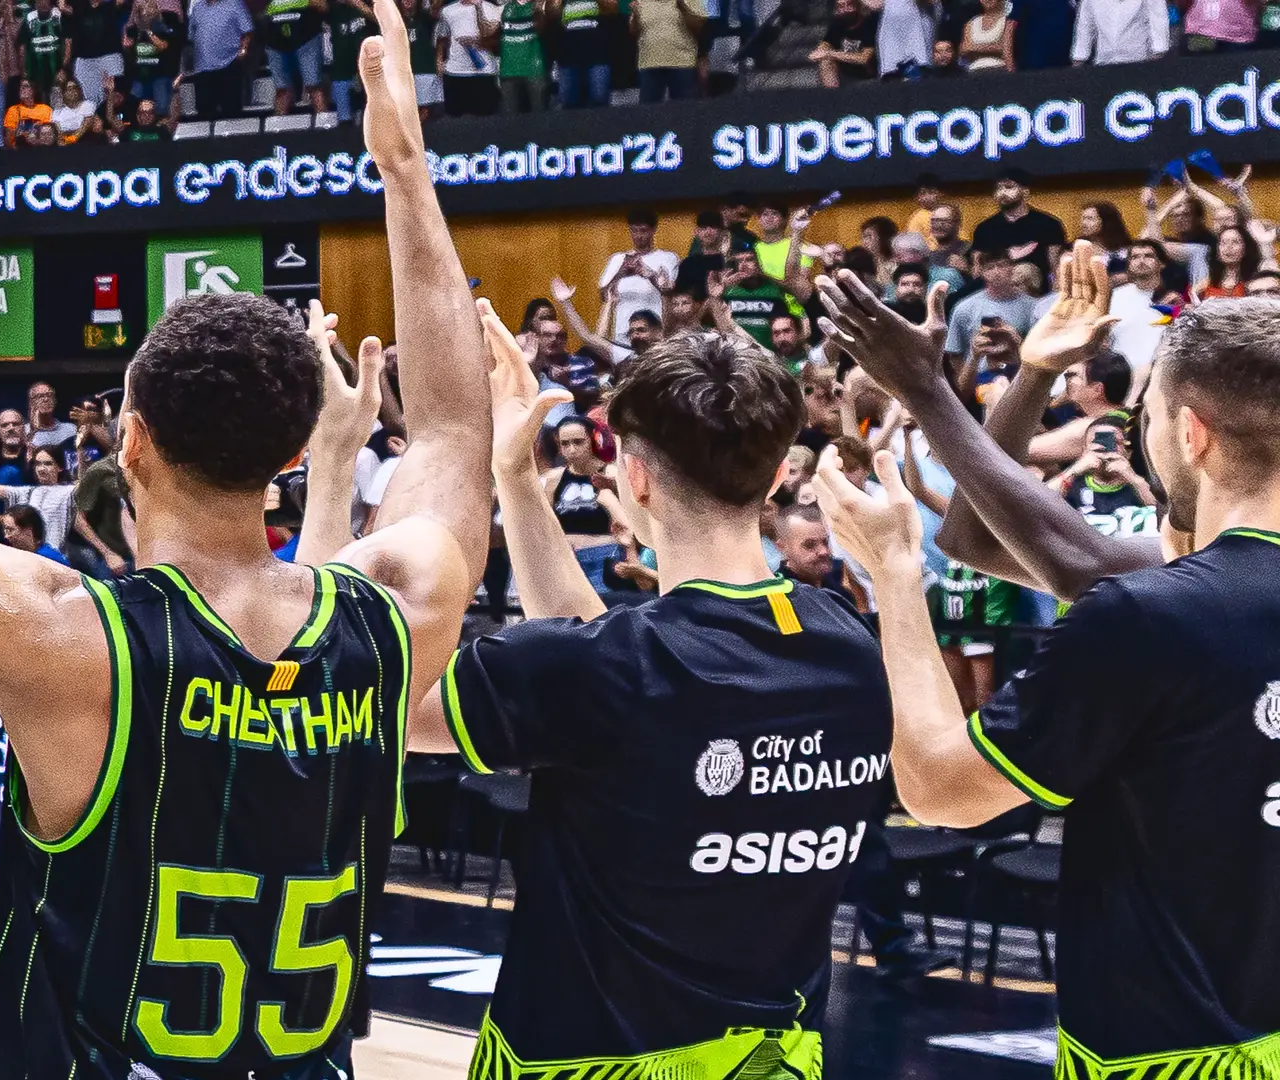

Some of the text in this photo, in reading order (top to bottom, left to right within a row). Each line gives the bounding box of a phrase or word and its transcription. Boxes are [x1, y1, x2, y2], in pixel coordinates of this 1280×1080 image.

[712, 98, 1086, 174] supercopa
[750, 753, 889, 796] BADALON
[752, 730, 824, 762] City of
[134, 863, 360, 1062] 55
